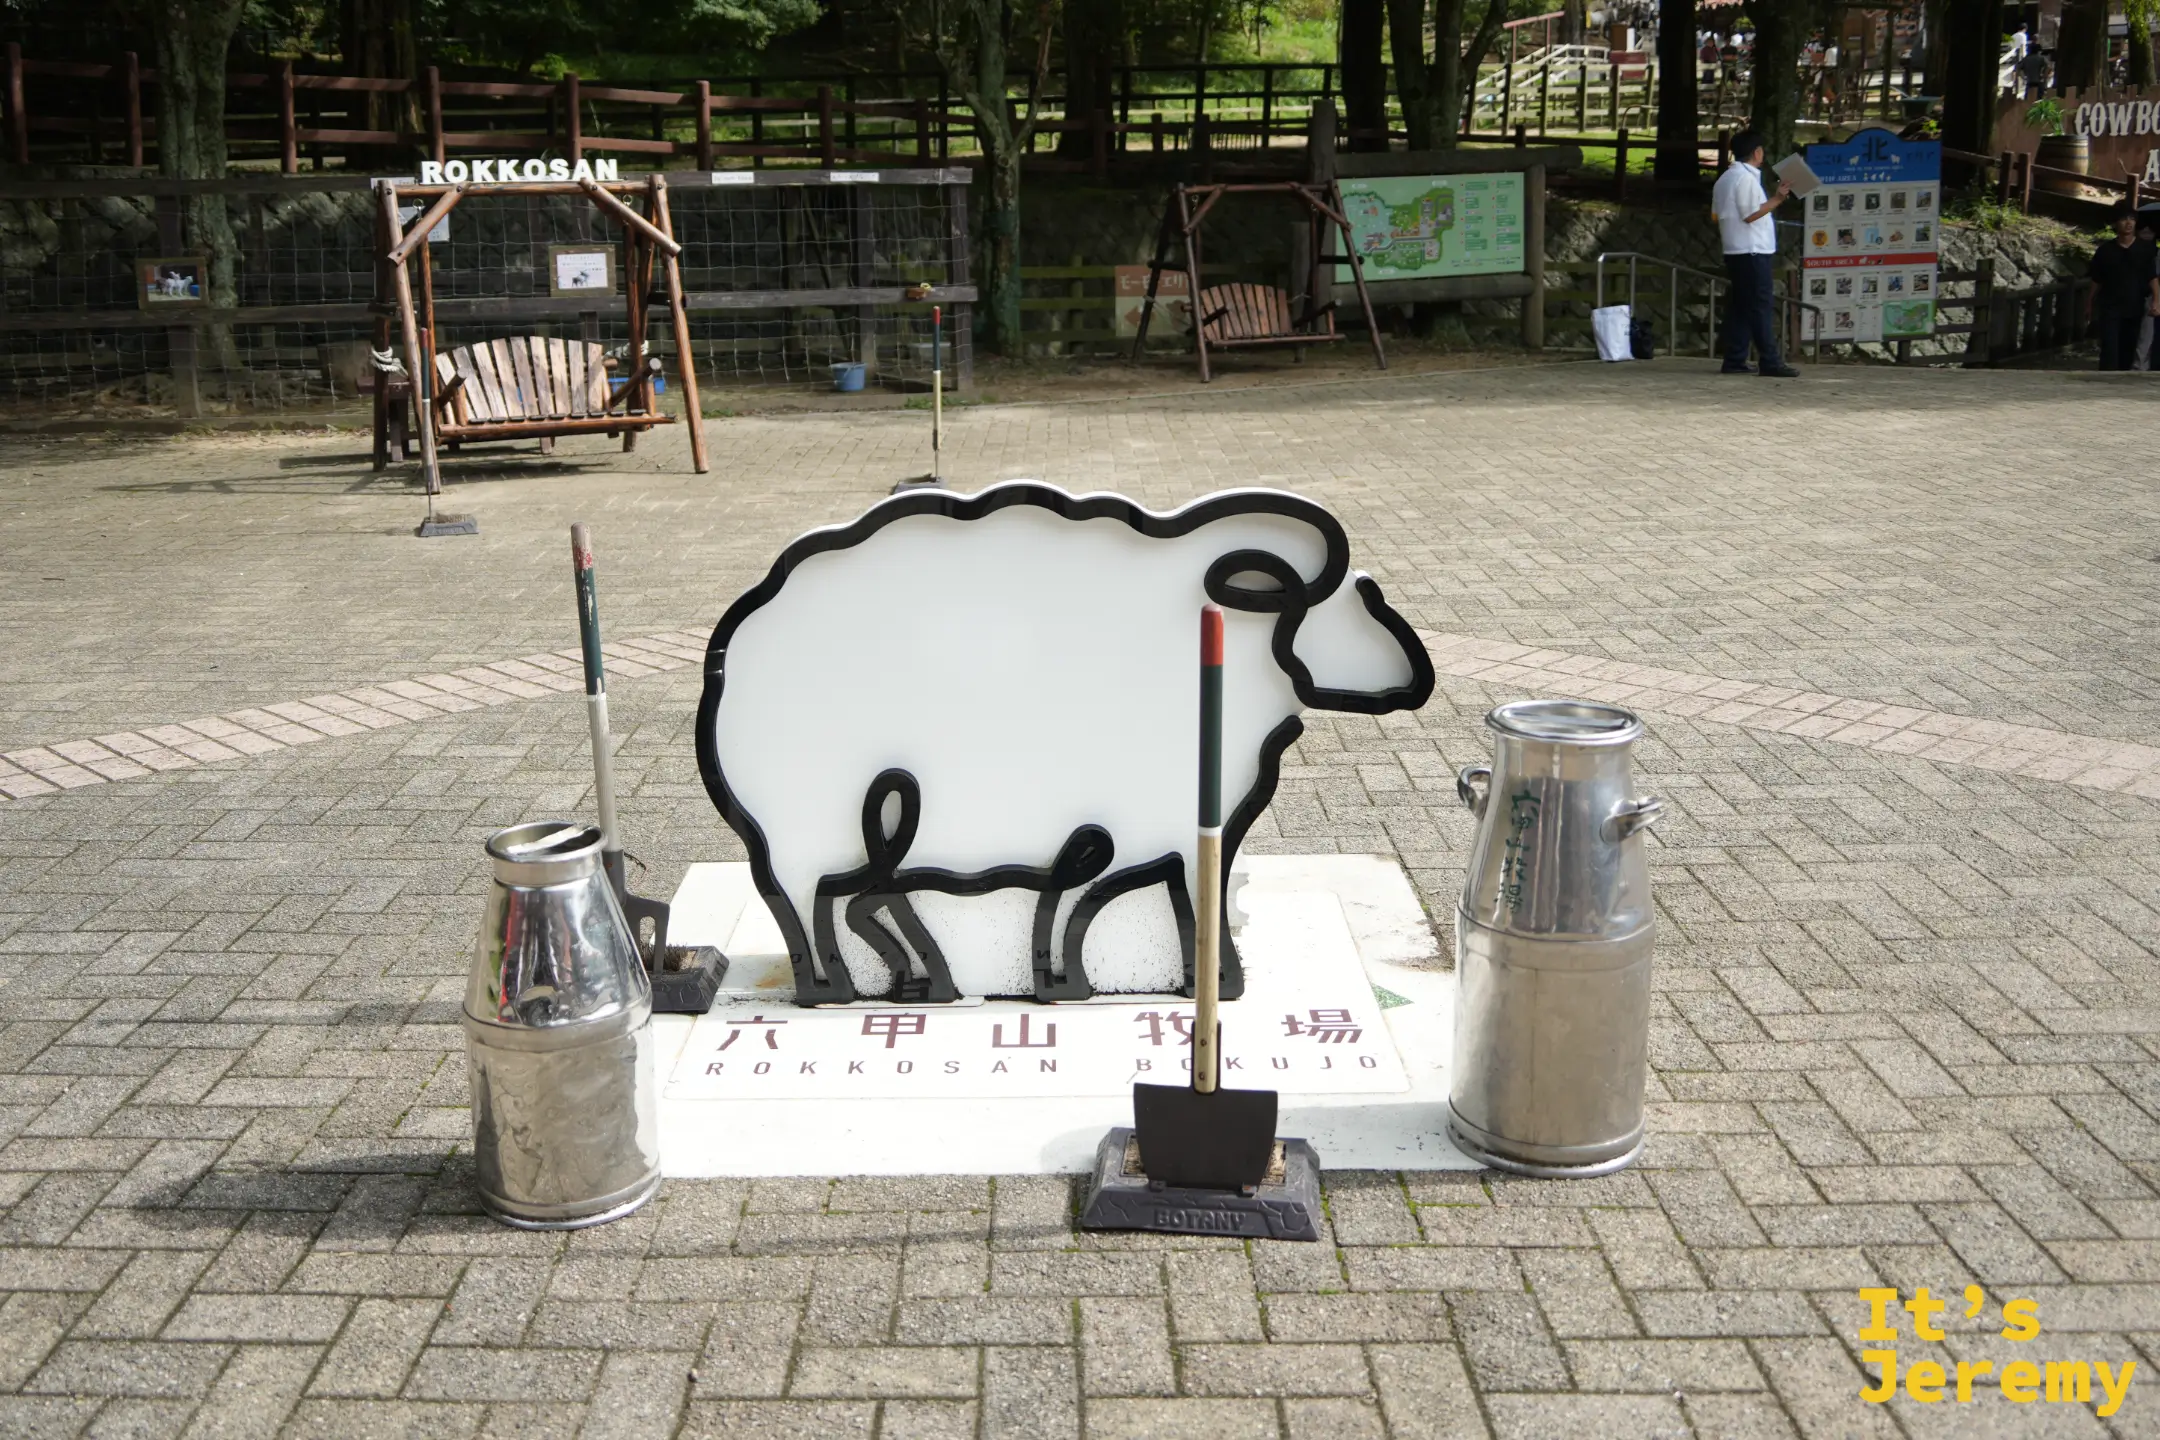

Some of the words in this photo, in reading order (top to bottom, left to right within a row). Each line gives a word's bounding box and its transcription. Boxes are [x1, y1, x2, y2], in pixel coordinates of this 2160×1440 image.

[1862, 136, 1889, 162] 北
[421, 158, 619, 184] ROKKOSAN
[705, 1059, 1058, 1076] ROKKOSAN
[1153, 1208, 1248, 1232] BOTANY
